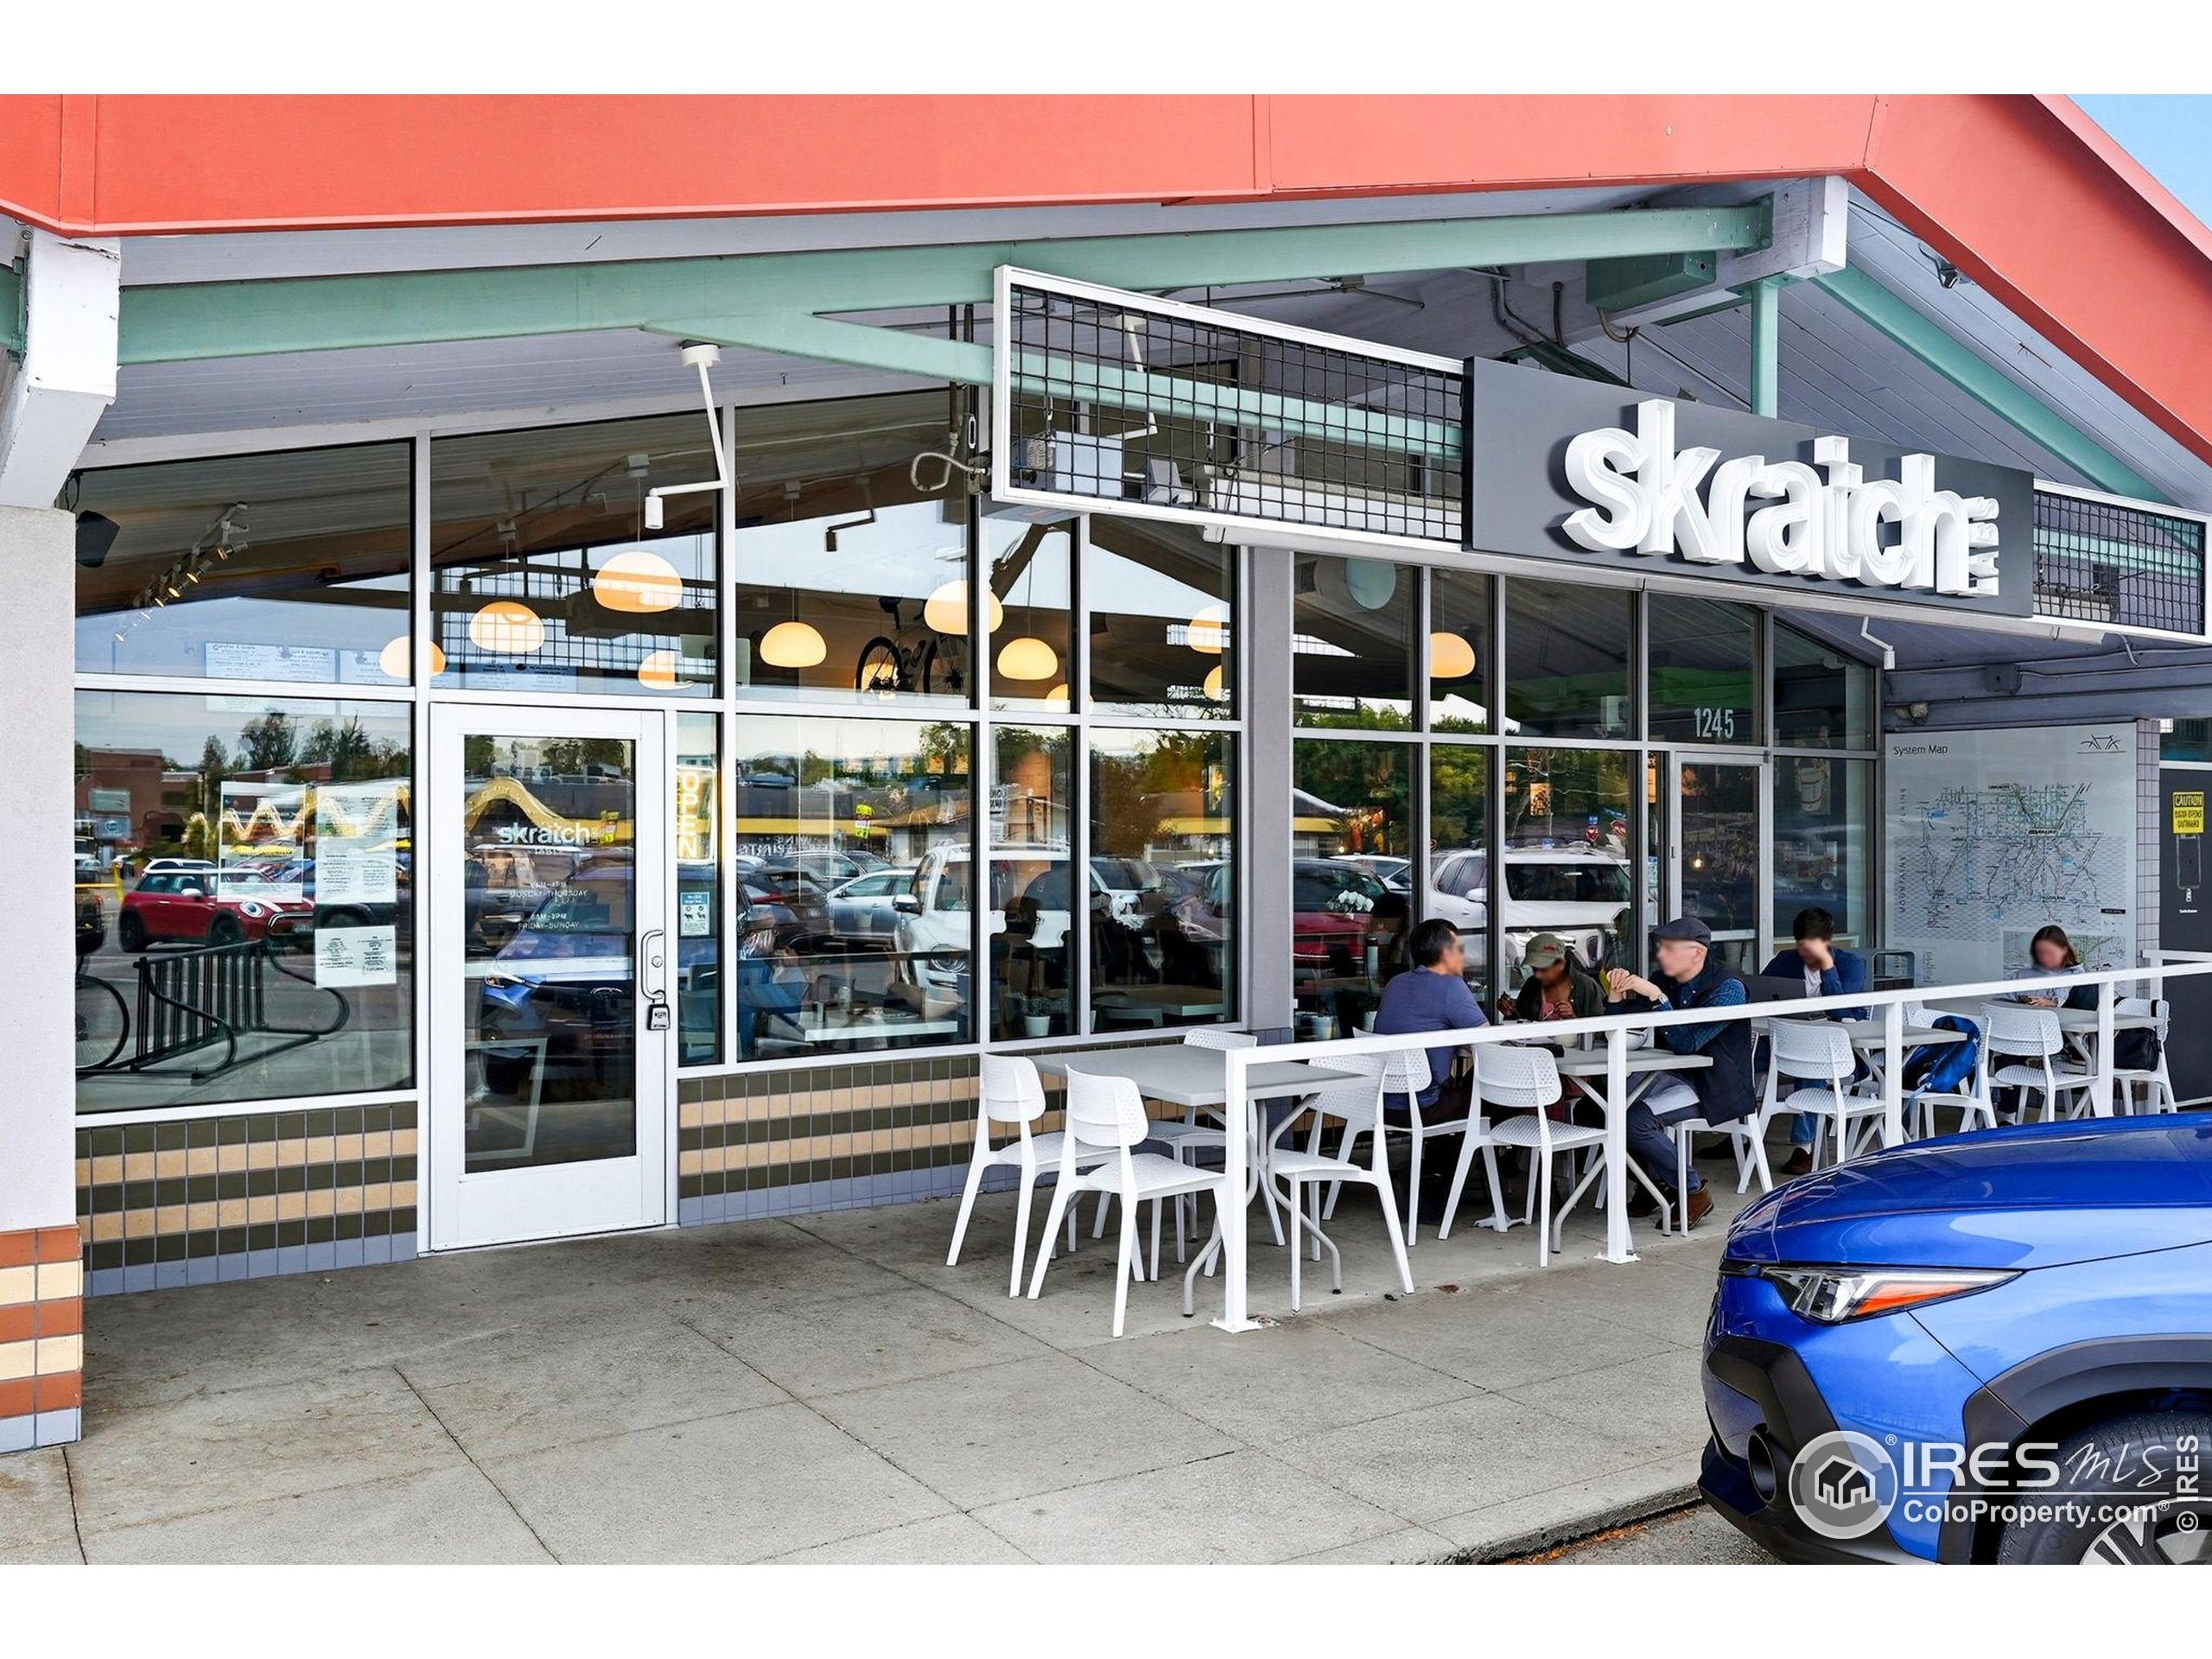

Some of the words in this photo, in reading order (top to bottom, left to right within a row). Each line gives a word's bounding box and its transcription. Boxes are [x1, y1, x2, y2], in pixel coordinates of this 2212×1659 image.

[1561, 398, 1972, 594] skratch
[1694, 707, 1734, 739] 1245
[1893, 746, 1926, 757] System
[1928, 745, 1948, 755] Map
[679, 771, 700, 858] OPEN
[498, 822, 590, 845] skratch
